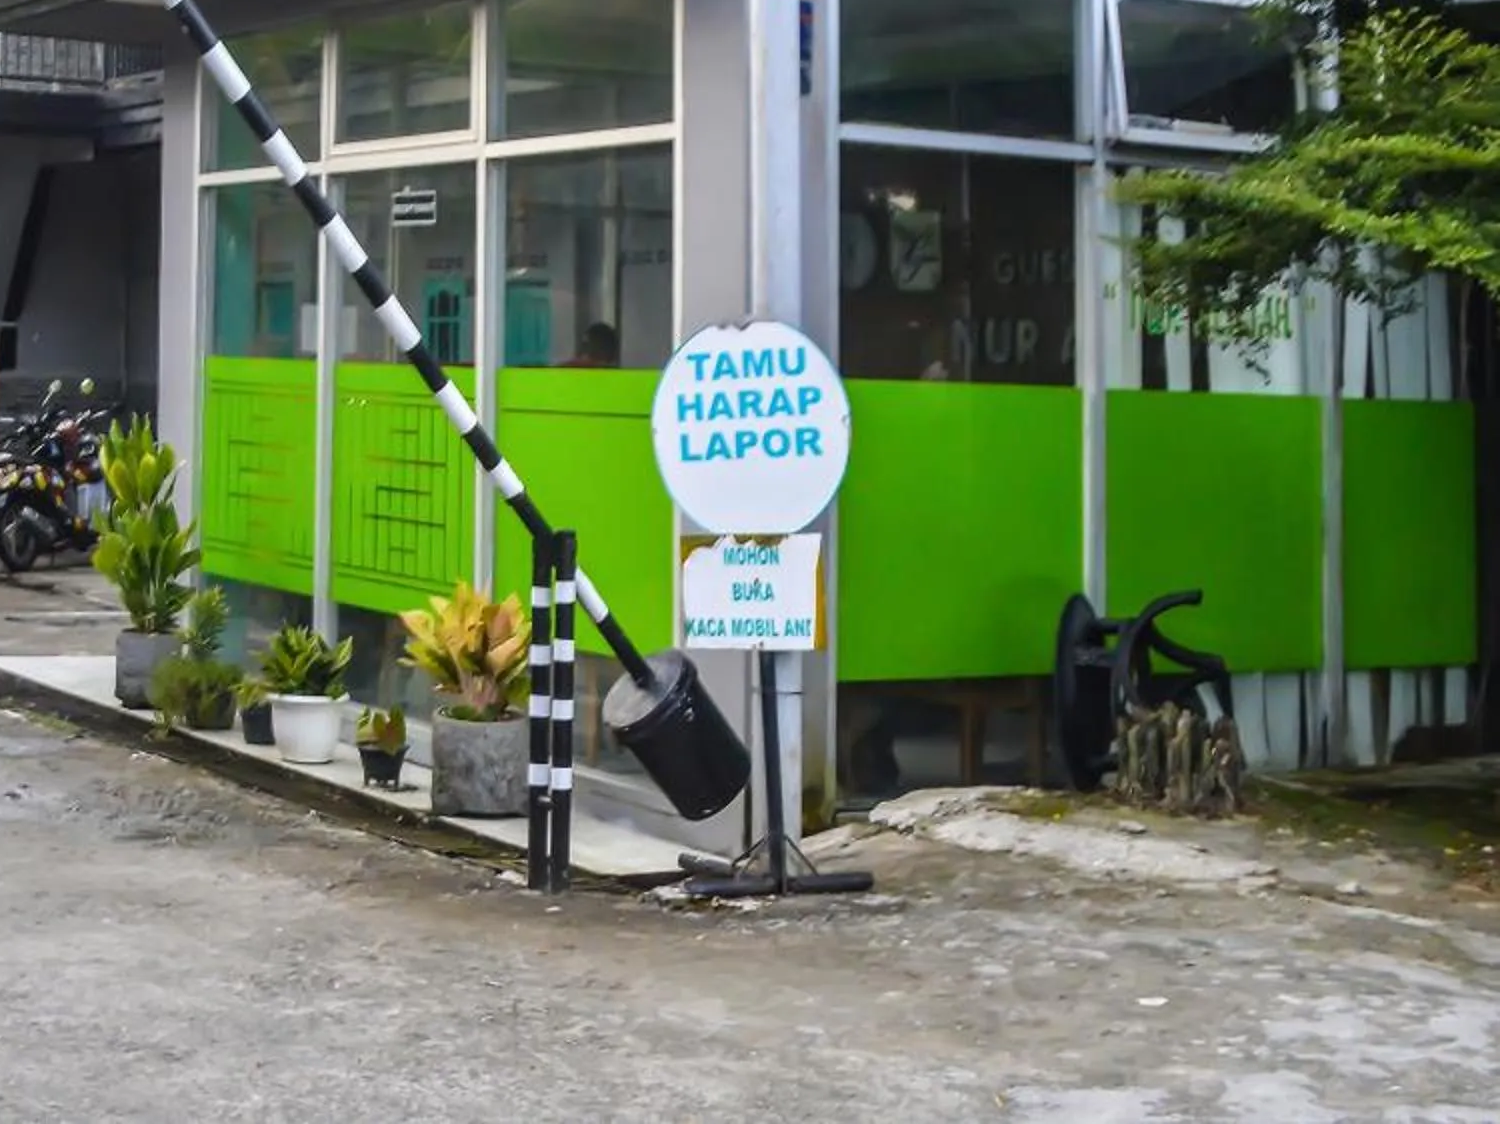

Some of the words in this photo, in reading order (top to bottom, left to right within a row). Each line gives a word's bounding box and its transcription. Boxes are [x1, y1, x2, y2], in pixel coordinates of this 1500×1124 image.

[950, 317, 1039, 365] NUR
[687, 347, 807, 381] TAMU
[677, 386, 822, 422] HARAP
[680, 427, 823, 462] LAPOR
[723, 545, 780, 565] MOHON
[732, 581, 775, 601] BUKA
[684, 618, 726, 637] KACA
[731, 618, 780, 637] MOBIL
